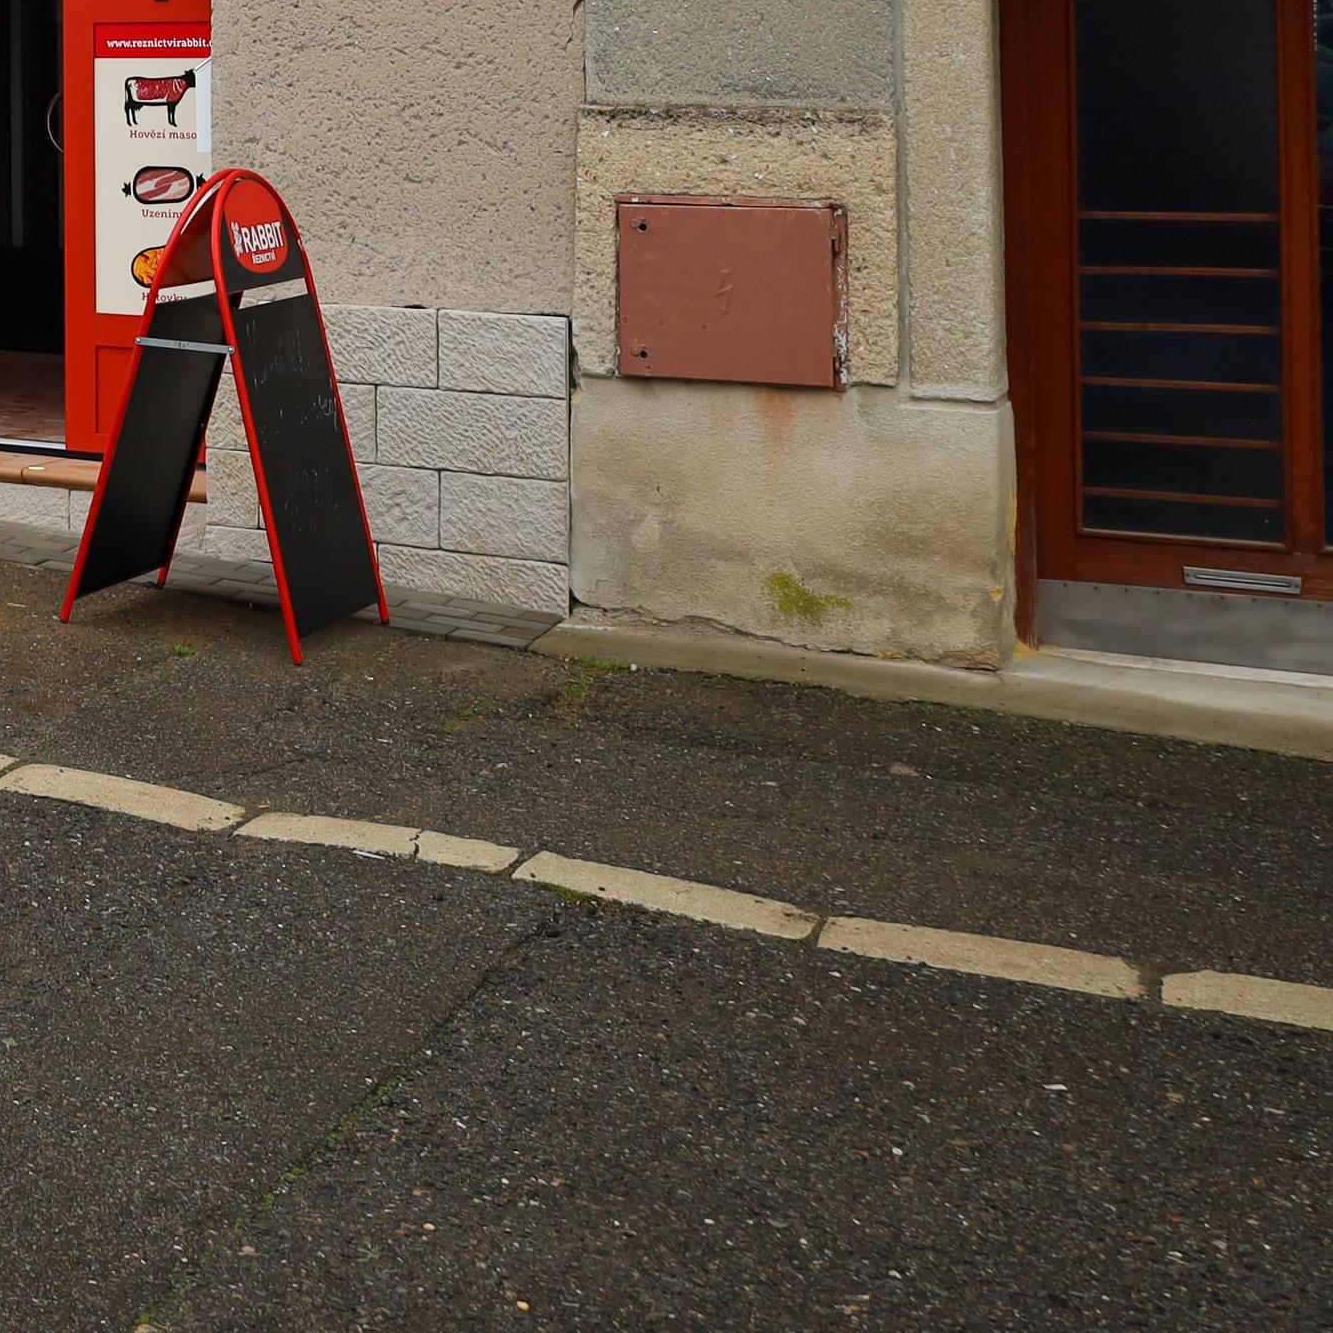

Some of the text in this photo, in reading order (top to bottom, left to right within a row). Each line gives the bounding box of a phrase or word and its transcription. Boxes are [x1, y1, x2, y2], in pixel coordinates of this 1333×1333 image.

[129, 129, 197, 140] Hovězí maso
[241, 221, 284, 253] RABBIT
[252, 251, 277, 265] ŘEZNICTVÍ
